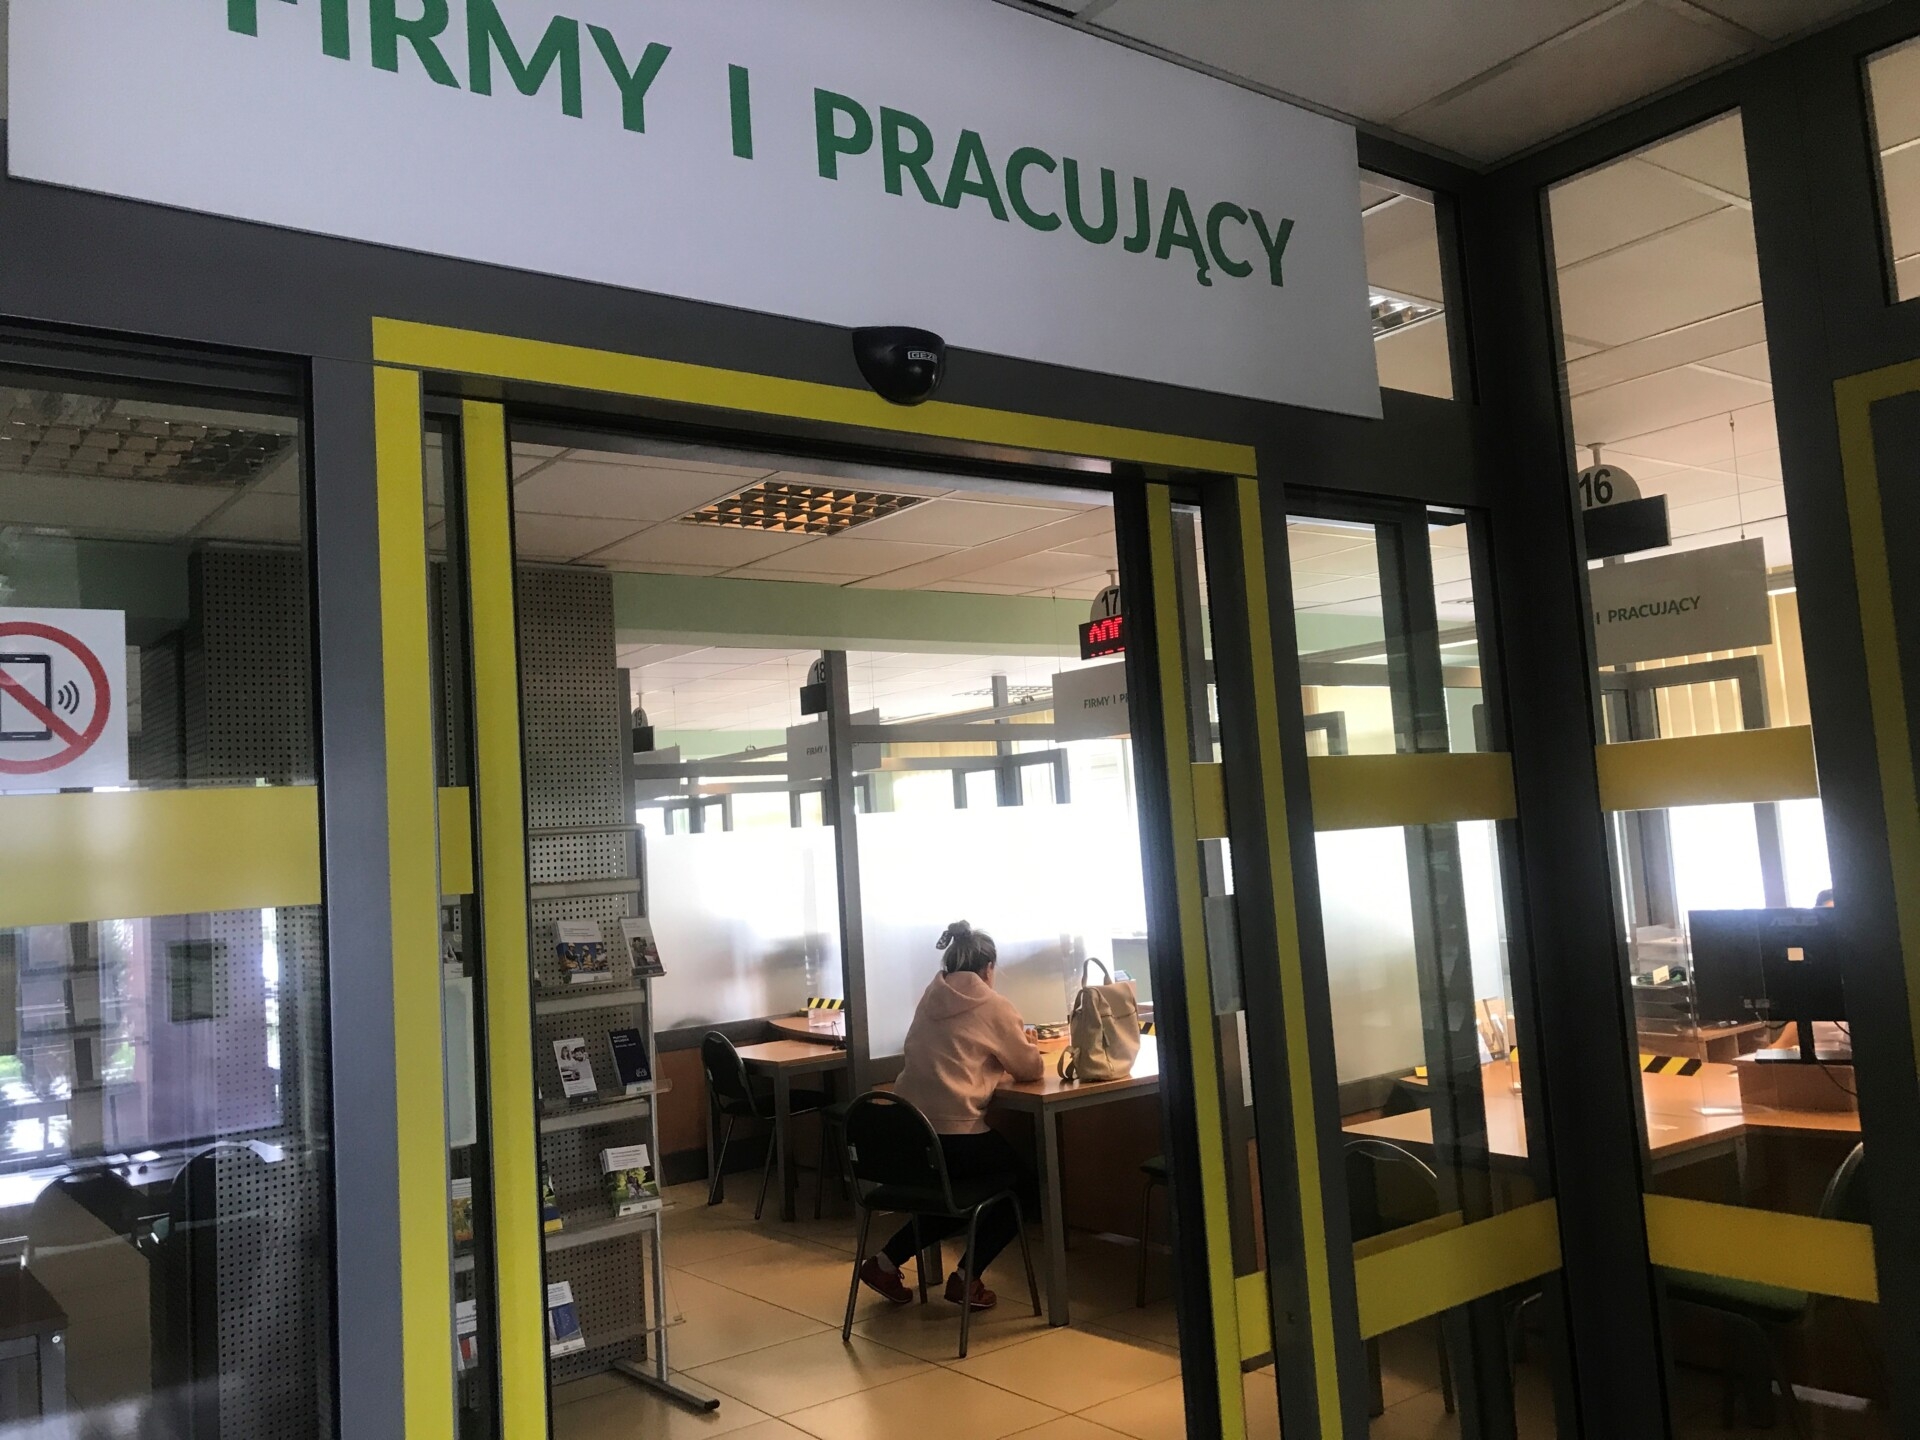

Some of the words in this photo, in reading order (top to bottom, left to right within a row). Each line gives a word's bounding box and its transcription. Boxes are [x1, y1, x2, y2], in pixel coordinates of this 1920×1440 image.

[728, 63, 754, 160] I
[813, 87, 1295, 288] PRACUJĄCY
[1579, 468, 1613, 507] 16
[1101, 589, 1119, 616] 17
[1596, 612, 1600, 624] I
[1607, 595, 1701, 624] PRACUJĄCY
[814, 661, 826, 683] 18
[1084, 696, 1110, 709] FIRMY
[1113, 694, 1116, 704] I
[634, 709, 643, 728] 19
[806, 745, 823, 756] FIRMY
